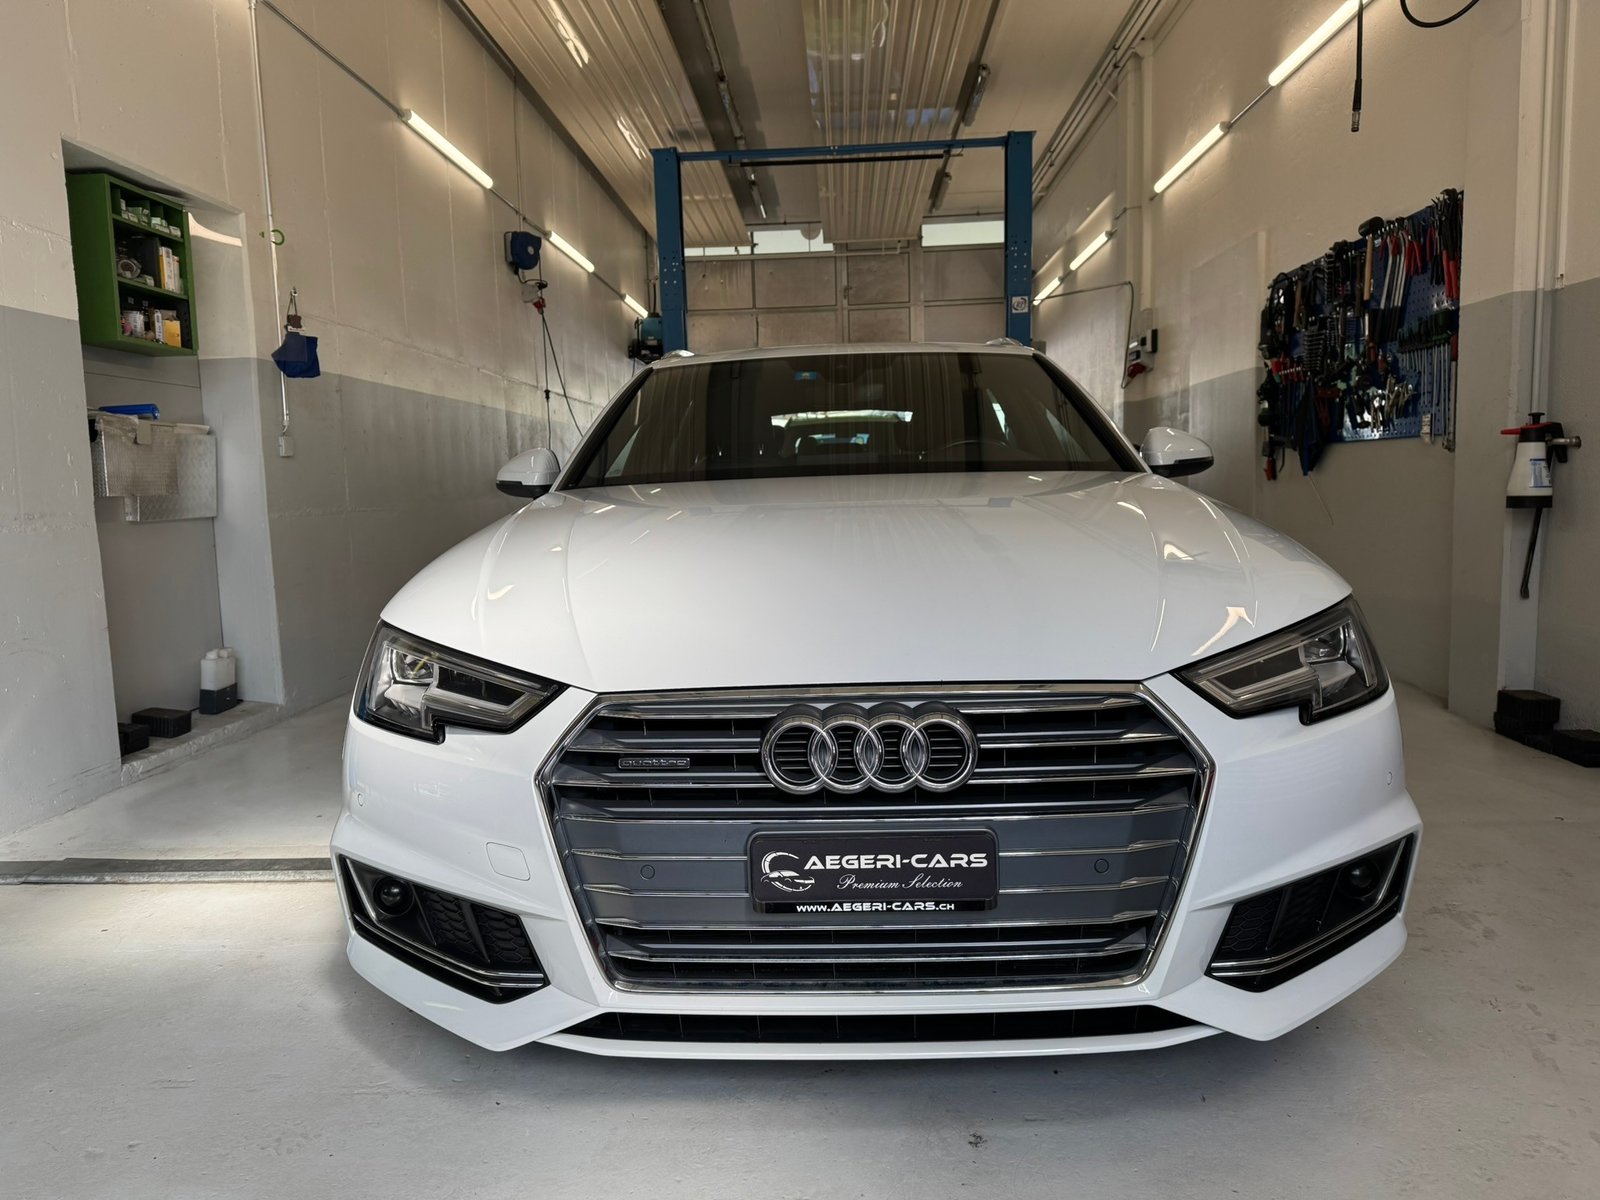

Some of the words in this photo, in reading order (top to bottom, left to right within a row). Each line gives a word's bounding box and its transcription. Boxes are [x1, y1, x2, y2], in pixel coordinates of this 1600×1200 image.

[804, 853, 988, 869] AEGERI-CARS
[836, 873, 900, 890] Premium
[901, 872, 963, 889] Selection
